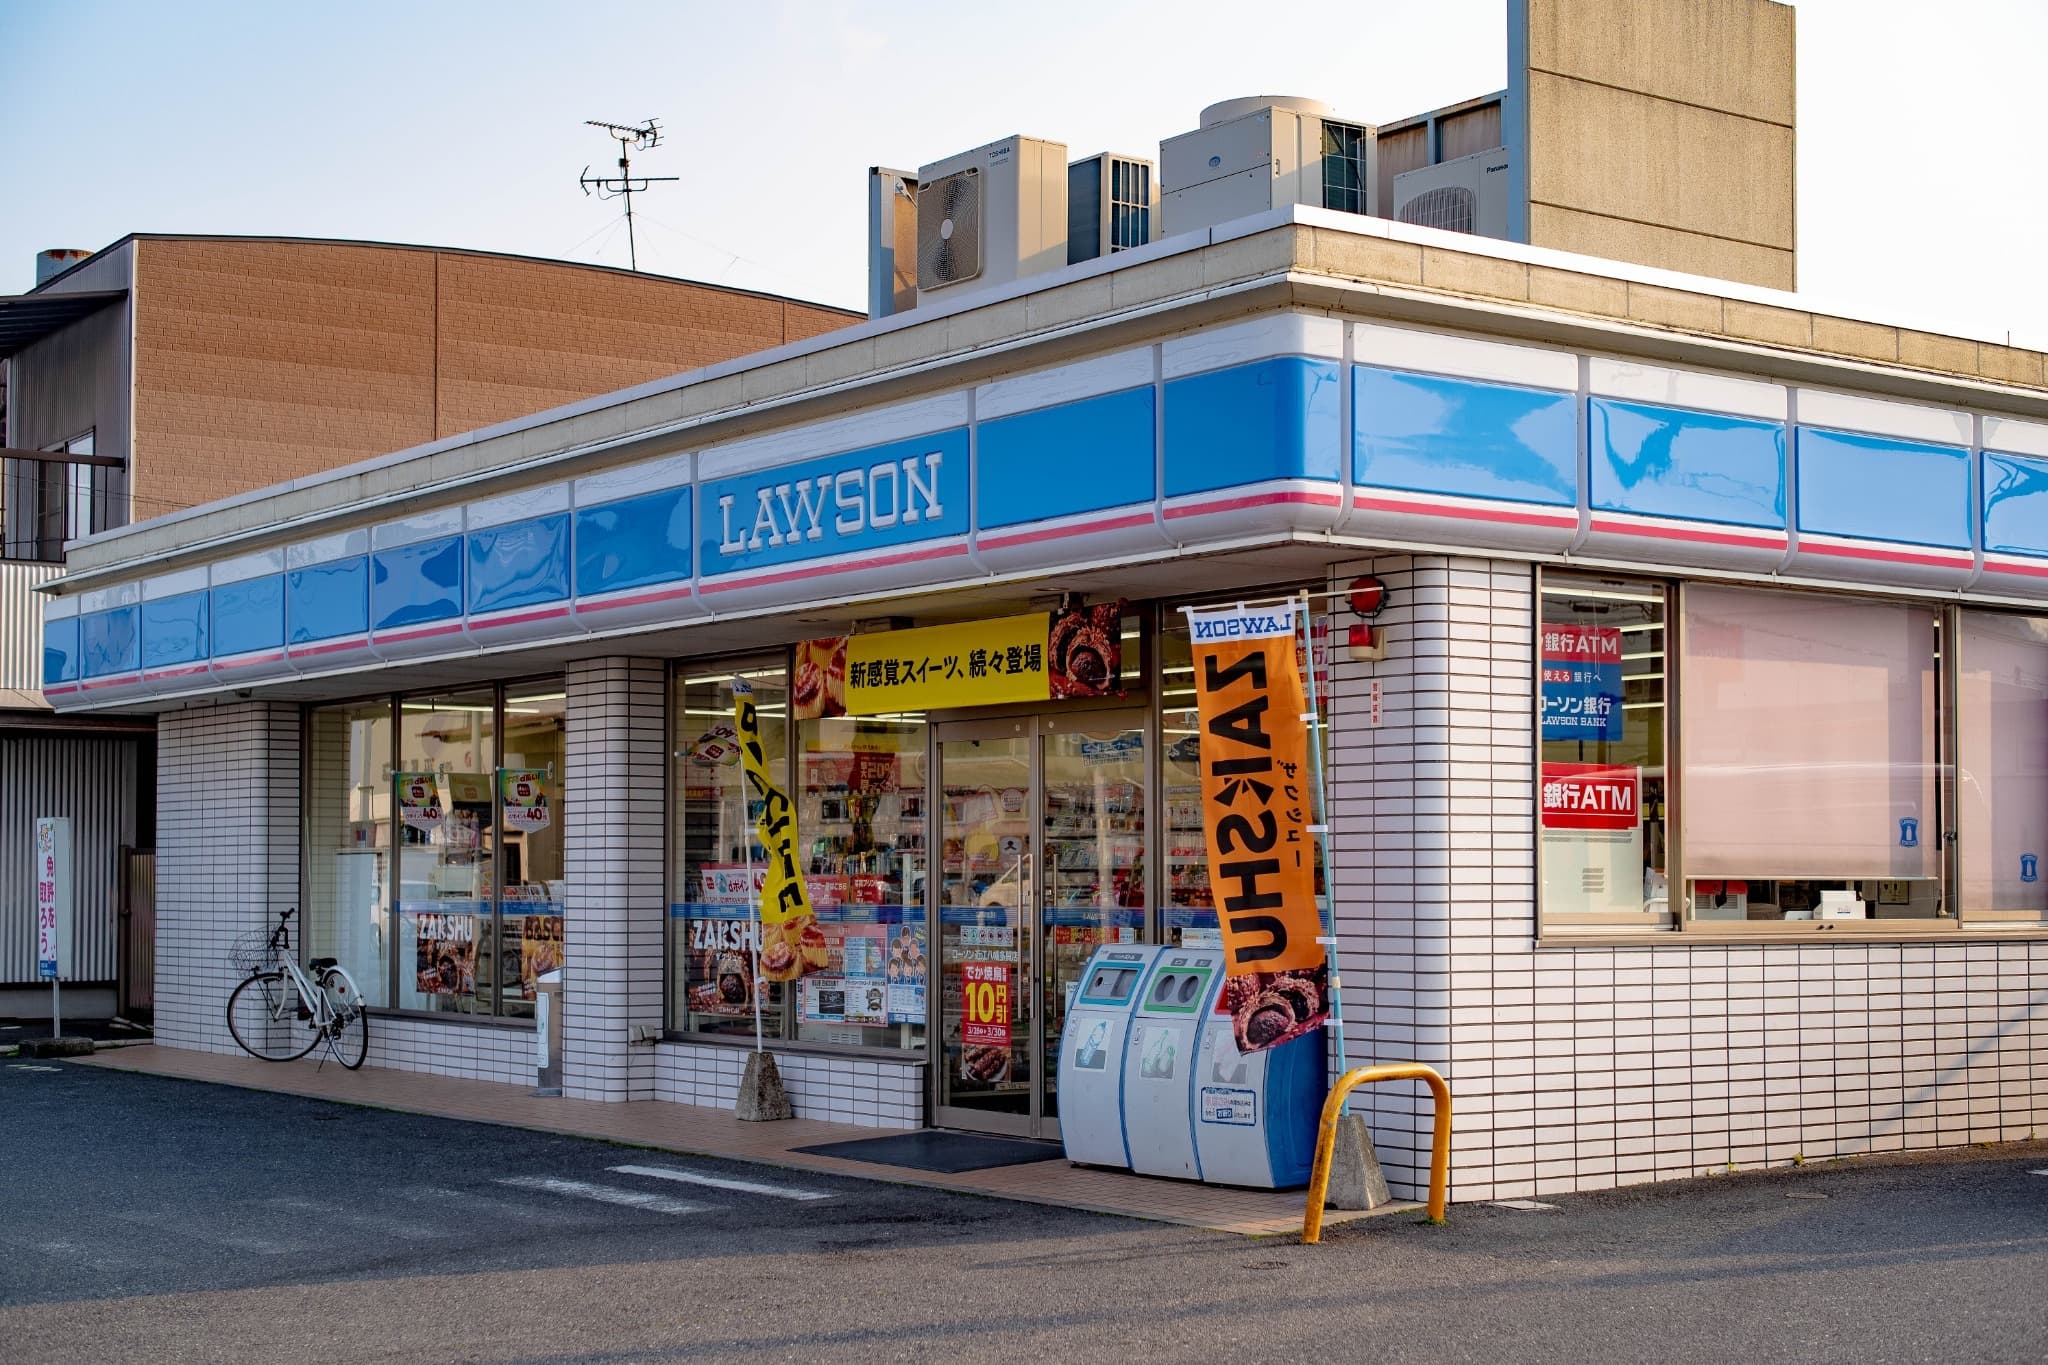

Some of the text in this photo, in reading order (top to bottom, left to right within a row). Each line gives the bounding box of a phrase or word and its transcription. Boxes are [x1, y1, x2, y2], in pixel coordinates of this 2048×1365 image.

[719, 451, 943, 556] LAWSON
[1541, 632, 1617, 655] 銀行ATM
[850, 643, 1042, 690] 新感覚スイーツ、続々登場
[1580, 717, 1607, 727] BANK
[1543, 783, 1632, 811] 銀行ATM
[965, 982, 994, 1023] 10
